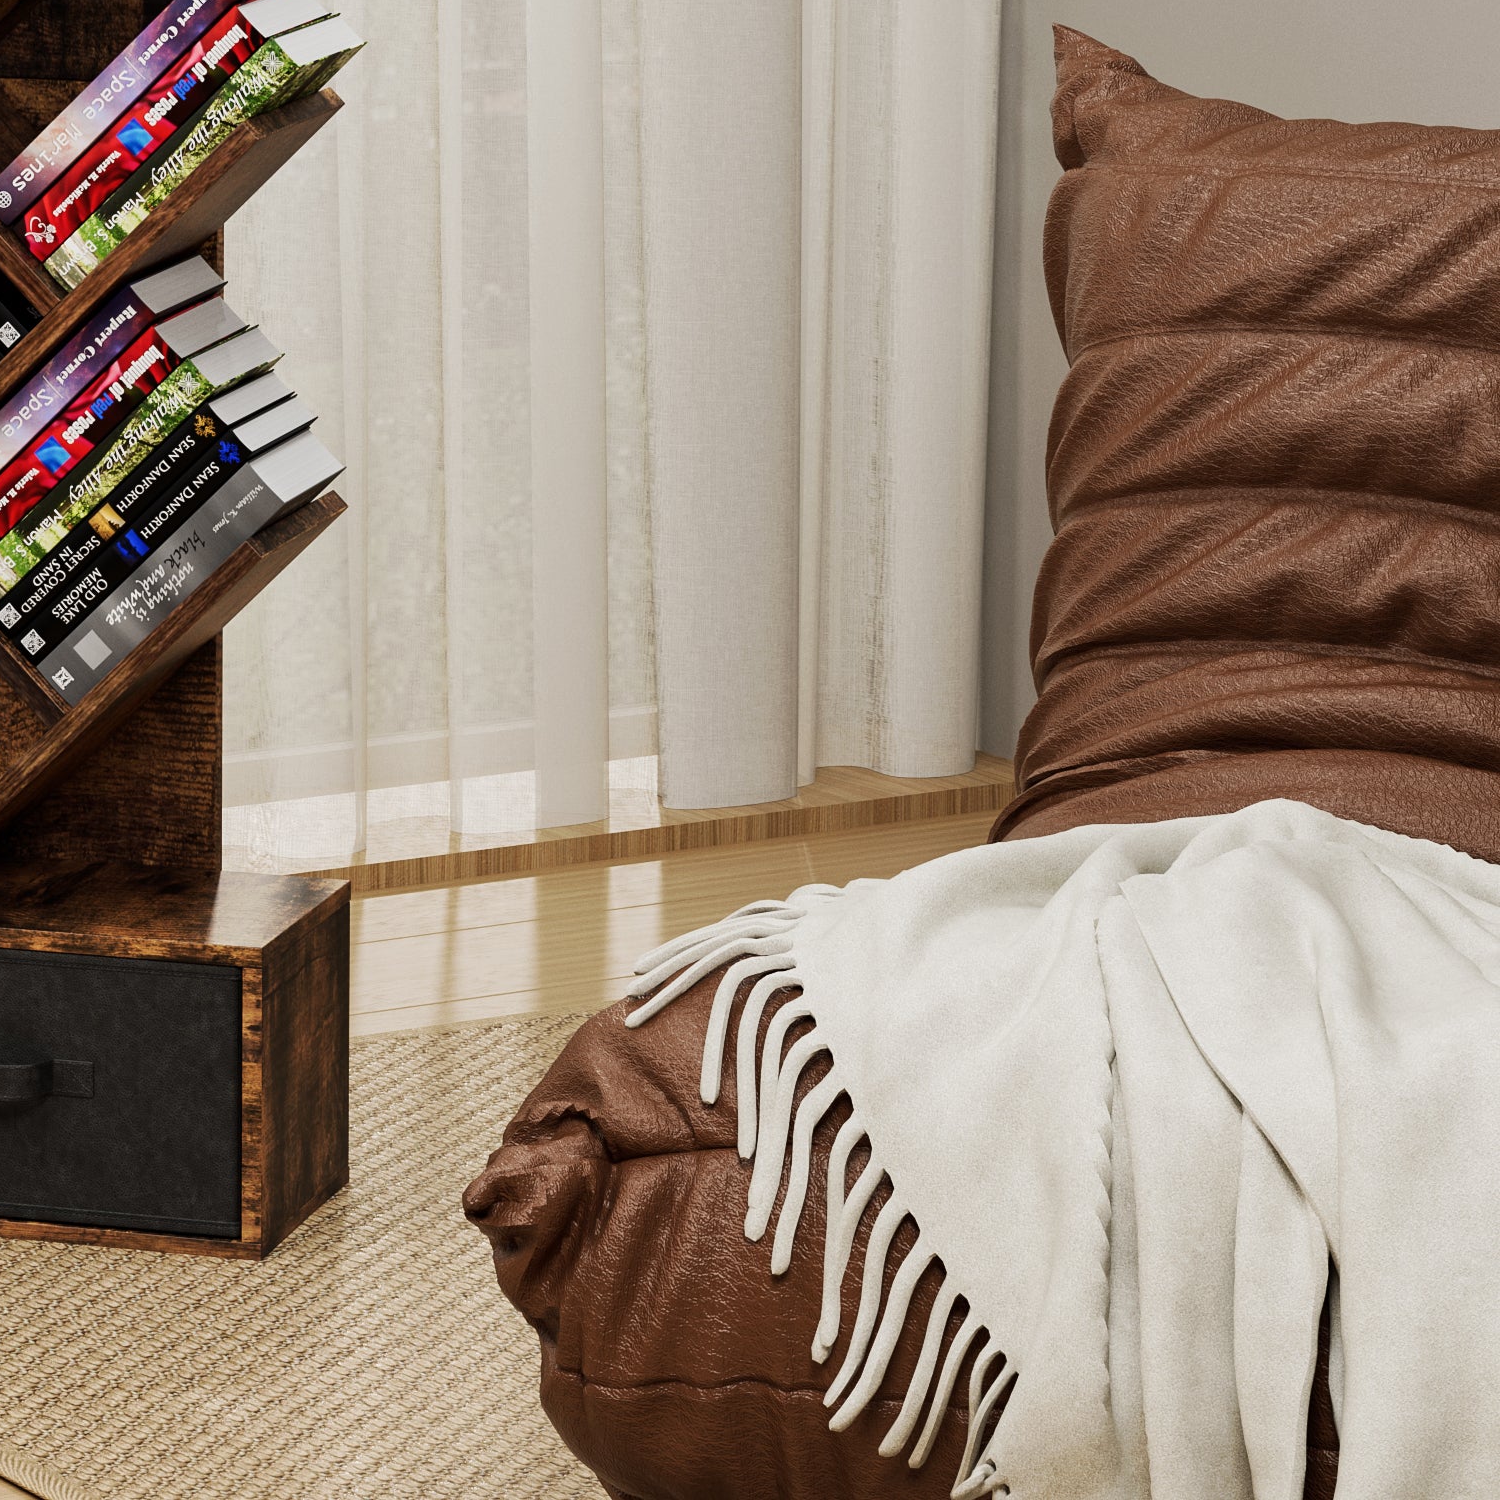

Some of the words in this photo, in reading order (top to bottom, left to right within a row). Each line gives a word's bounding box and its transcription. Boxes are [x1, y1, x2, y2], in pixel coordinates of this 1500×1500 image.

[138, 24, 179, 65] Cornet
[201, 25, 248, 70] bouquet
[173, 73, 196, 100] red
[191, 62, 208, 82] of
[83, 70, 136, 121] Space
[144, 92, 178, 127] roses
[208, 71, 269, 127] Walking
[186, 125, 214, 150] the
[12, 123, 82, 191] Marines
[96, 150, 120, 174] Valerie
[150, 148, 189, 186] Alley
[88, 171, 98, 182] H.
[53, 180, 90, 217] McNicholas
[95, 305, 136, 346] Rupert
[56, 344, 96, 384] Cornet
[118, 345, 164, 389] bouquet
[90, 393, 114, 419] red
[108, 382, 125, 401] of
[2, 388, 53, 438] Space
[62, 411, 95, 445] roses
[125, 392, 185, 447] Walking
[103, 444, 130, 470] the
[7, 489, 17, 499] H.
[15, 467, 39, 491] Valerie
[68, 468, 106, 503] Alley
[164, 530, 207, 572] black
[134, 565, 167, 597] and
[141, 562, 195, 611] nothing
[105, 589, 143, 626] white
[135, 607, 151, 621] is
